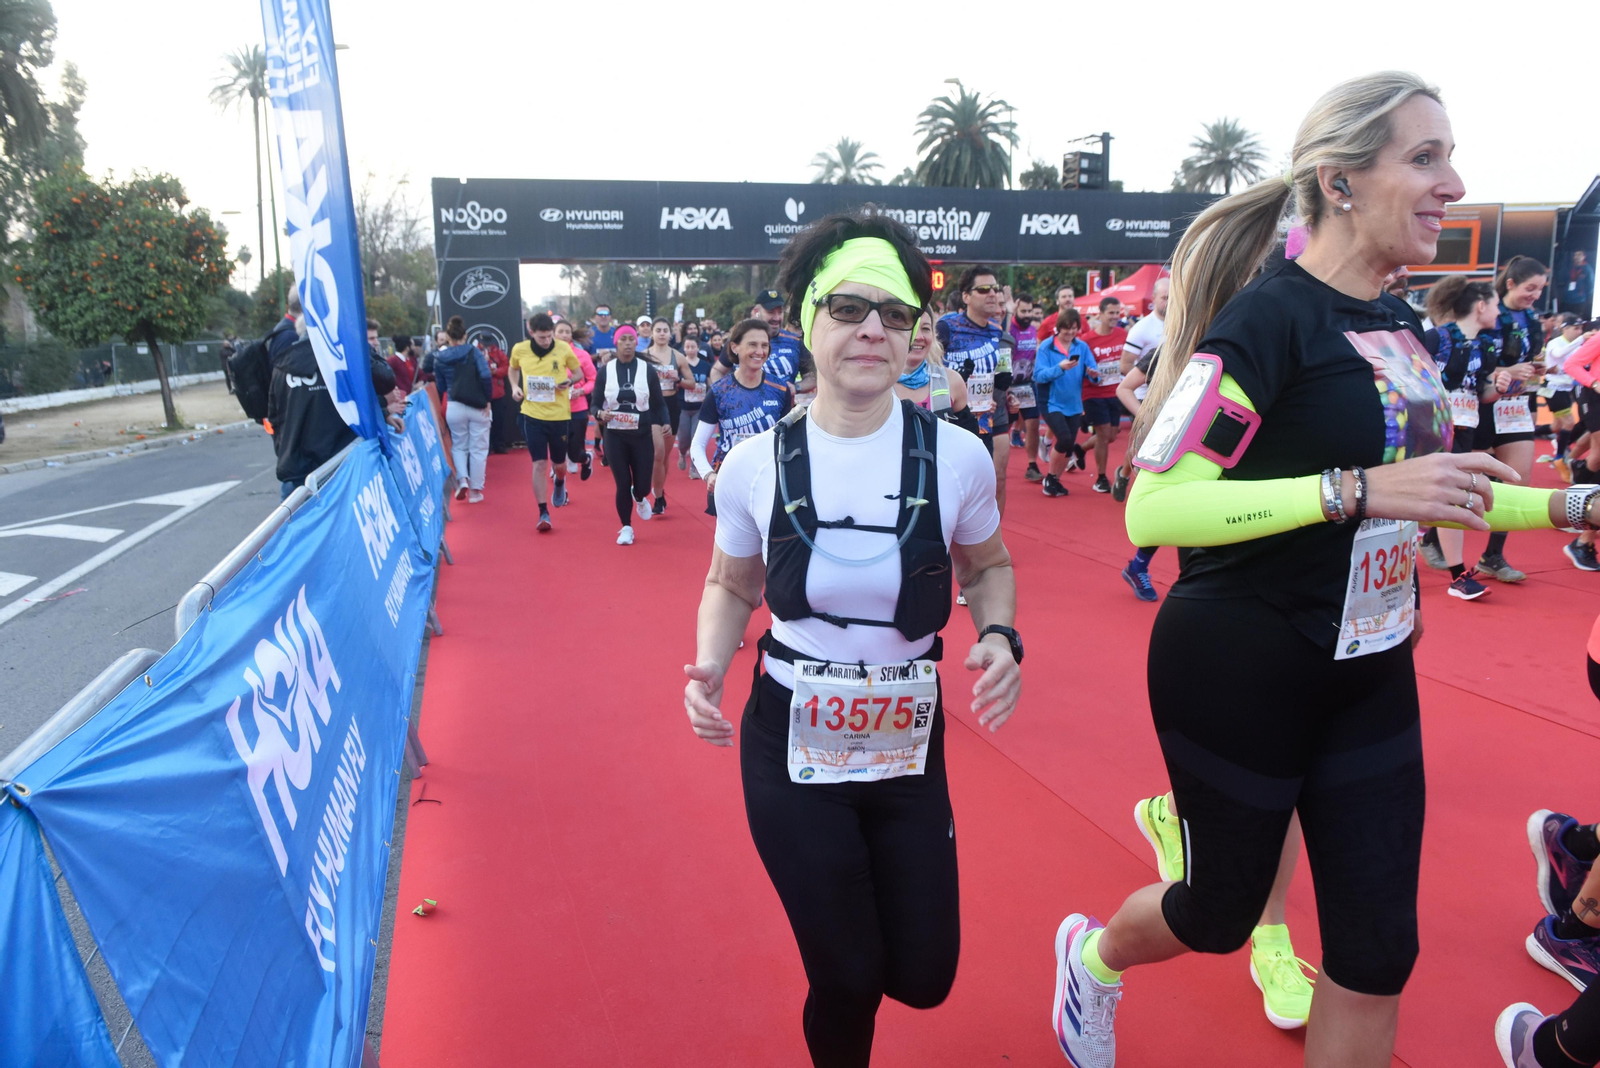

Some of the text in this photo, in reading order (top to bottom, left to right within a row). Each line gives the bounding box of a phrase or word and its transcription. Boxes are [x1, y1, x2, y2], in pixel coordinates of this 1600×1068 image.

[565, 209, 624, 221] HYUNDAI
[660, 206, 731, 230] HOKA
[1020, 213, 1081, 235] HOKA
[1124, 219, 1170, 230] HYUNDAI
[603, 222, 624, 231] Motor
[935, 244, 957, 254] 2024
[733, 406, 765, 428] MARATÓN
[352, 471, 401, 581] HOKA
[827, 665, 862, 680] MARATÓN
[804, 695, 914, 732] 13575
[225, 583, 341, 878] HOKA
[843, 732, 871, 741] CARINA
[305, 714, 366, 973] FLY HUMAN FLY
